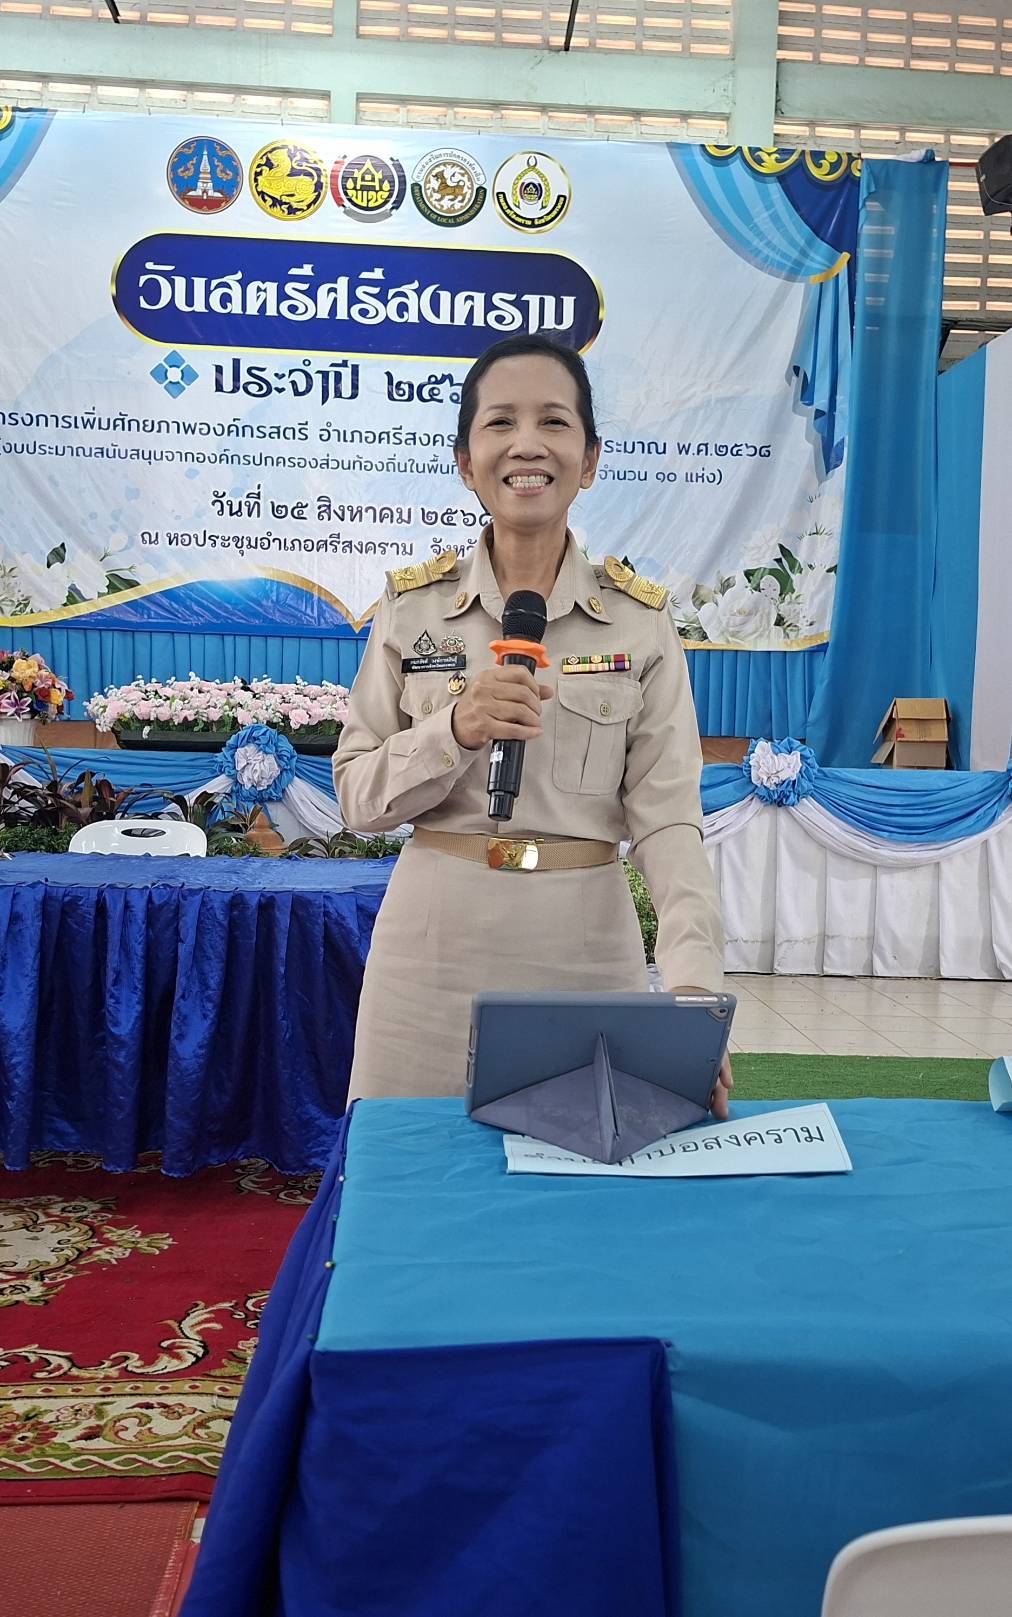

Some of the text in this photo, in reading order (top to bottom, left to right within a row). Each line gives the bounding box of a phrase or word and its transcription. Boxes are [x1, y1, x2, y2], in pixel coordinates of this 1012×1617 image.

[138, 262, 576, 334] วันสตรีศรีสงคราม
[211, 358, 463, 406] ประจำปี ๒๕๖
[319, 422, 457, 447] อำเภอศรีสงคร
[600, 436, 667, 456] ระมาณ
[677, 441, 771, 458] พ.ศ.๒๕๖๘
[655, 471, 677, 483] ๑๐
[685, 467, 723, 486] แห่ง)
[211, 484, 261, 519] วันที่
[270, 500, 309, 520] ๒๕
[317, 495, 411, 525] สิงหาคม
[140, 531, 159, 545] ณ
[166, 529, 413, 556] หอประชุมอำเภอศรีสงคราม
